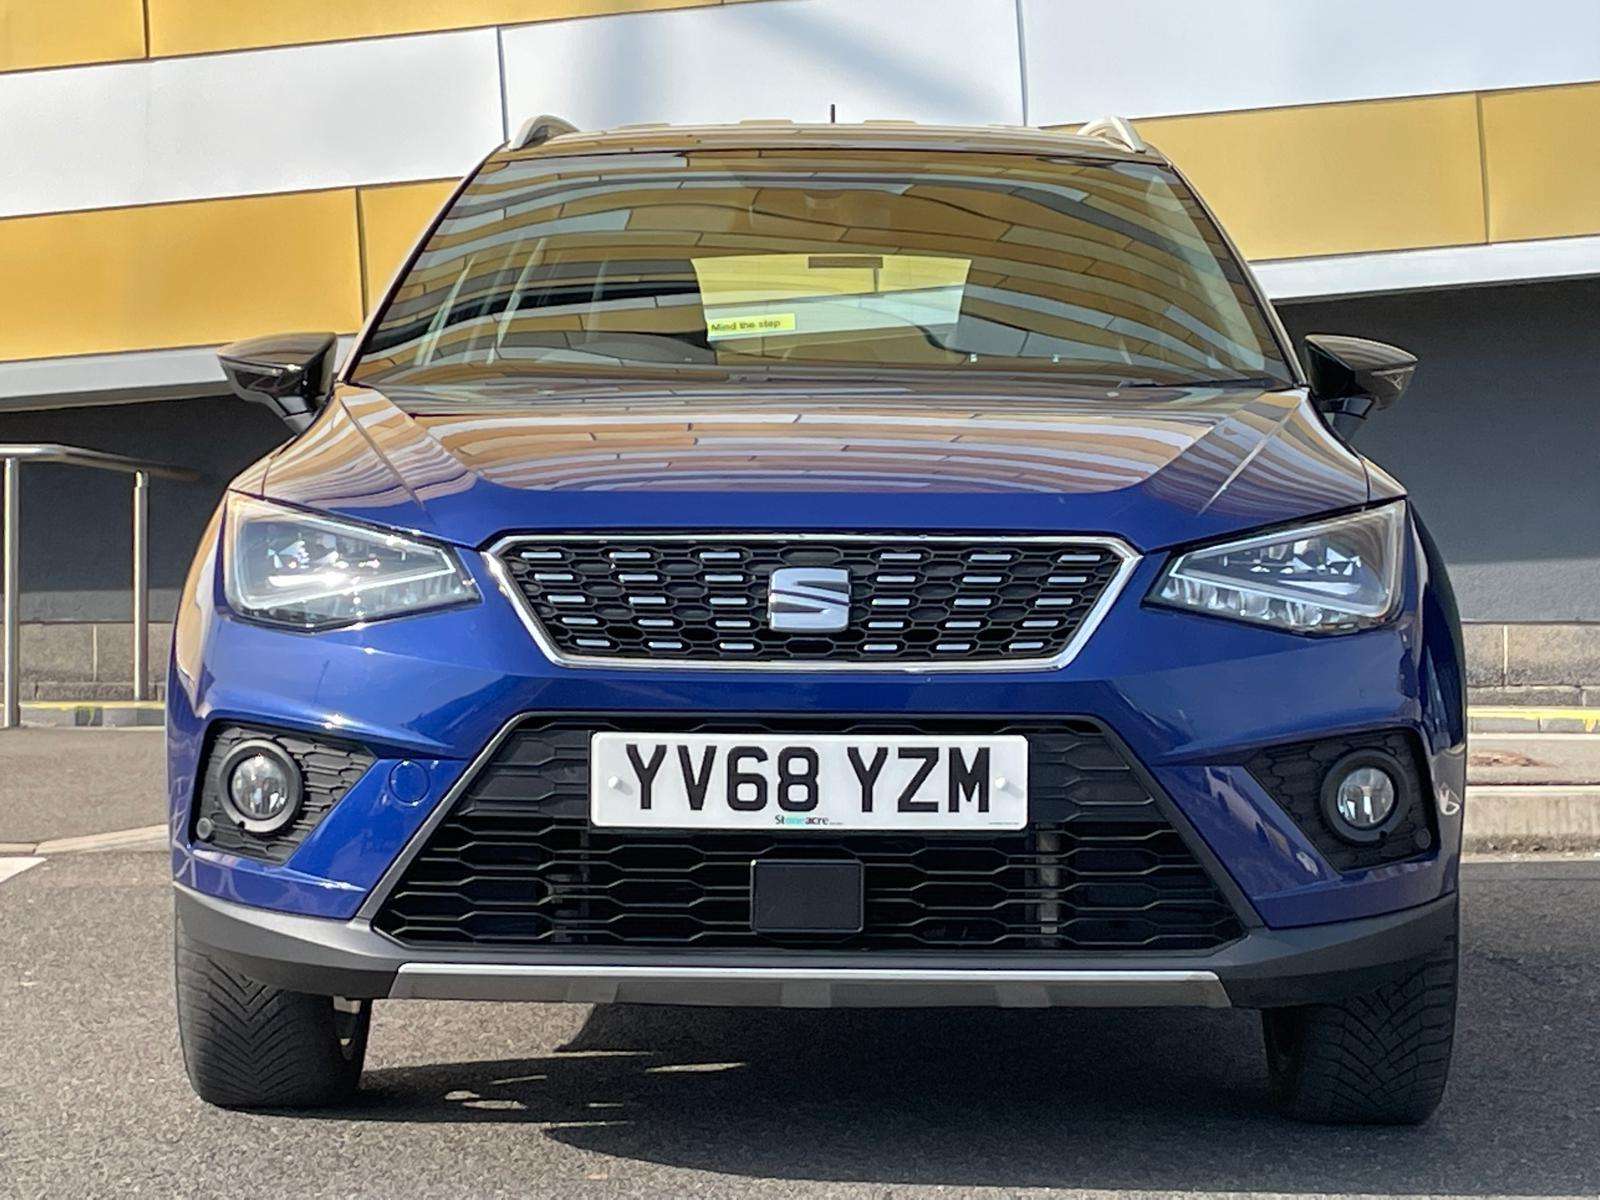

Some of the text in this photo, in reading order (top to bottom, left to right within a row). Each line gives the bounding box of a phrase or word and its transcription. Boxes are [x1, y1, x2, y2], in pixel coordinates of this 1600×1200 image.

[711, 319, 781, 331] Mind the step
[625, 744, 991, 813] YV68 YZM
[774, 814, 829, 826] Stoneacre
